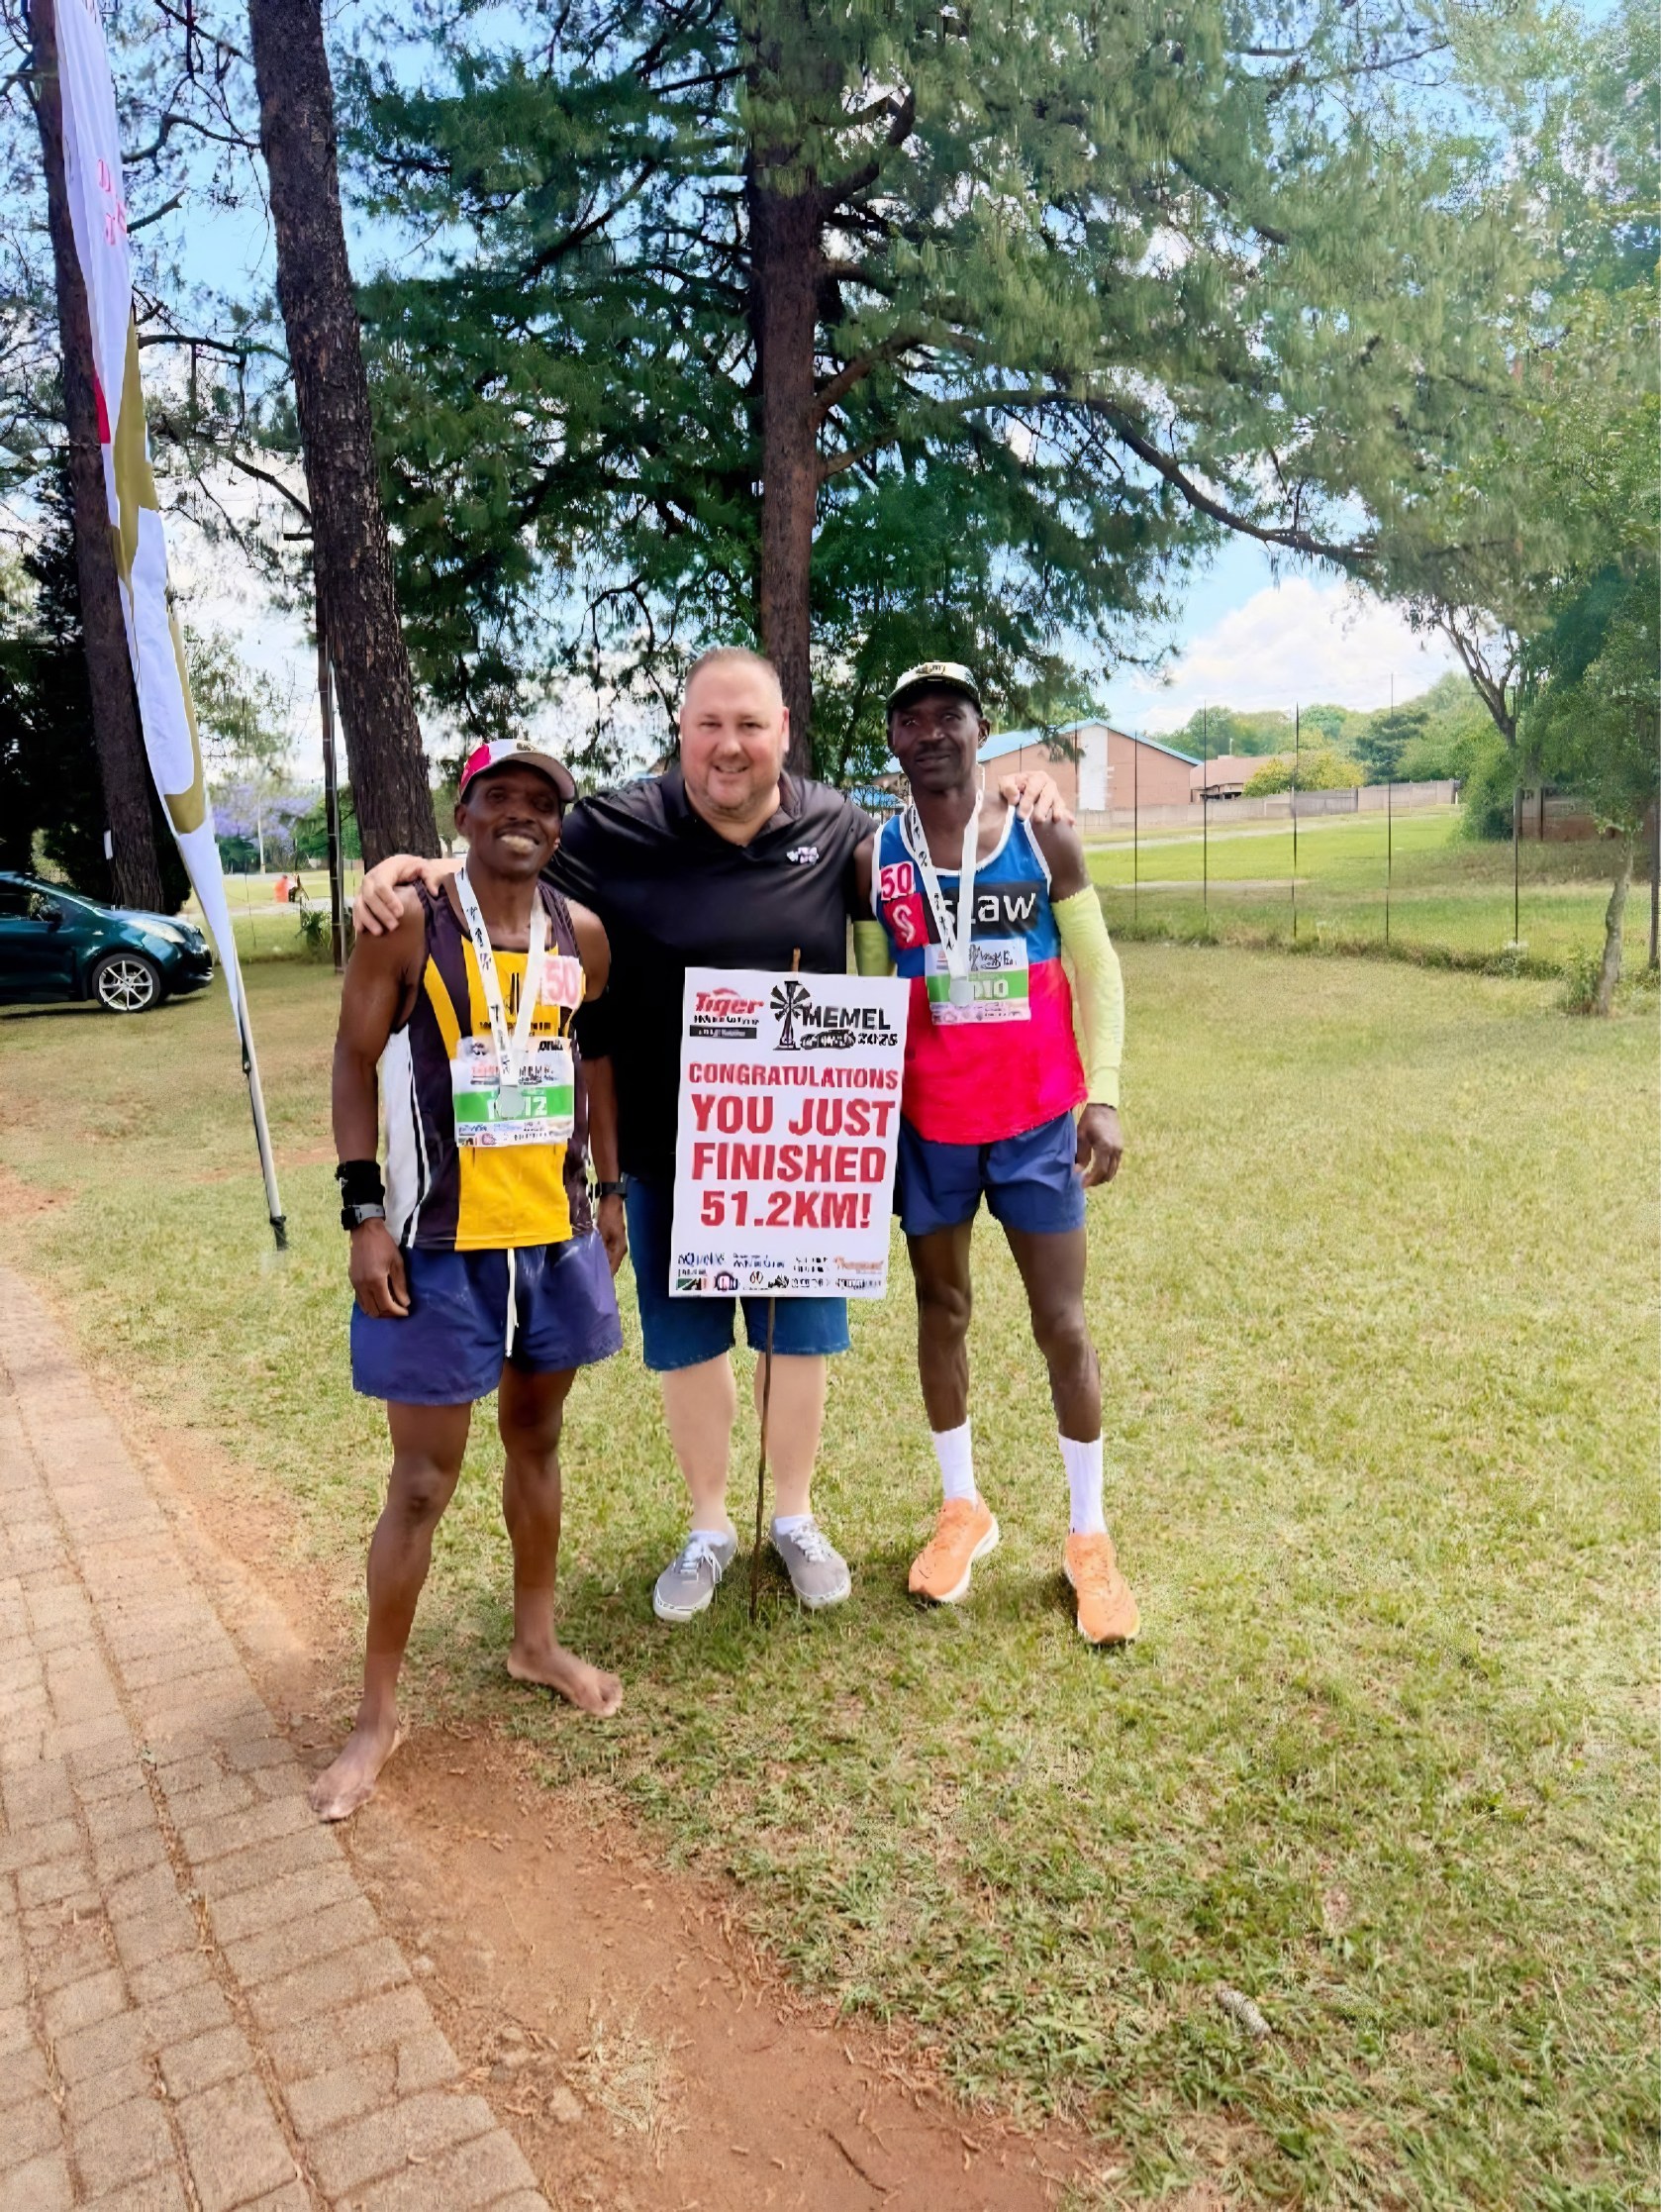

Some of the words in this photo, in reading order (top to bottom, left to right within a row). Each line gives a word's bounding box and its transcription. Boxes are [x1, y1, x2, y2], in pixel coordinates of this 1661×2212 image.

[881, 862, 912, 898] 50
[545, 960, 578, 1004] 50
[695, 991, 764, 1017] Tiger
[802, 1005, 891, 1030] MEMEL
[689, 1061, 899, 1090] CONGRATULATIONS
[691, 1094, 774, 1135] YOU
[788, 1097, 896, 1138] JUST
[691, 1143, 887, 1183] FINISHED
[701, 1190, 872, 1229] 51.2KM!
